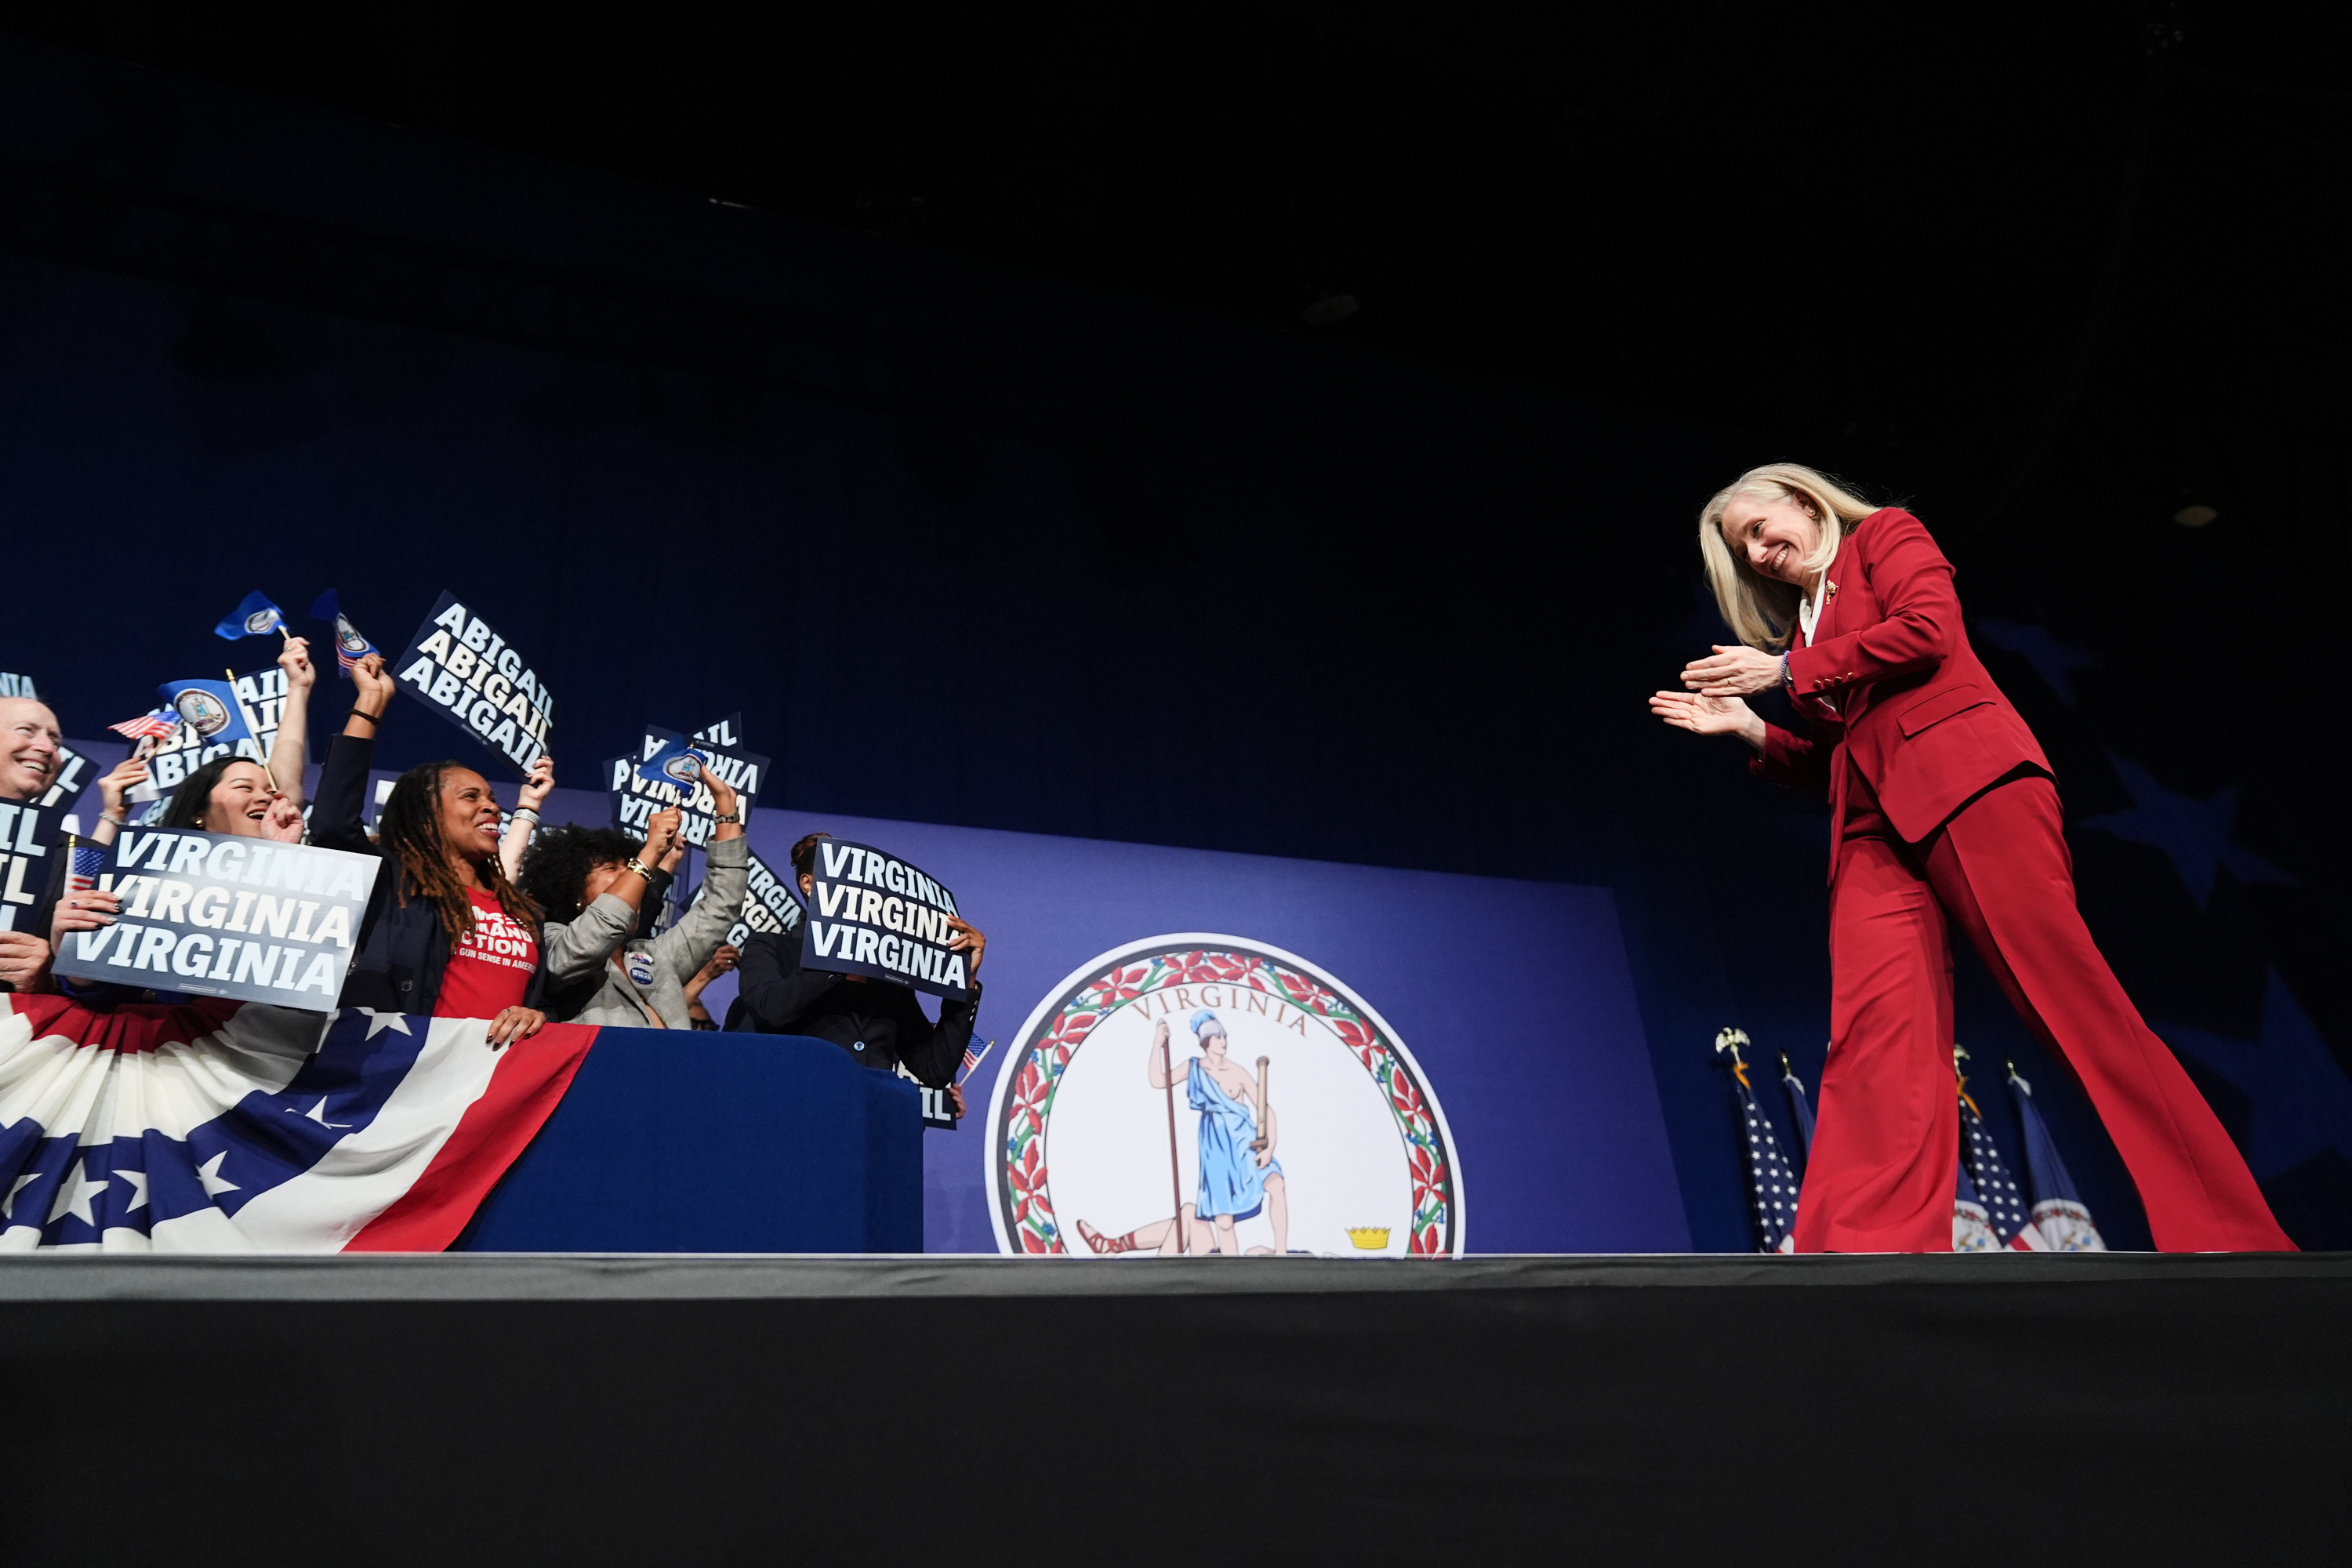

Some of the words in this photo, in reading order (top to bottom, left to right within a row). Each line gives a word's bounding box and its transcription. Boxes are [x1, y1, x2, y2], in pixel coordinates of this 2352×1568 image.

[416, 629, 547, 752] ABIGAIL
[434, 603, 553, 728] ABIGAIL
[398, 655, 543, 774] ABIGAIL
[116, 831, 364, 902] VIRGINIA
[822, 842, 960, 919] VIRGINIA
[98, 873, 350, 948] VIRGINIA
[461, 929, 527, 957] CTION
[816, 881, 962, 946] VIRGINI
[76, 922, 336, 996] VIRGINIA
[459, 947, 476, 958] GUN
[477, 952, 501, 964] SENSE
[502, 957, 510, 967] IN
[811, 920, 966, 989] VIRGINIA
[1131, 985, 1307, 1037] VIRGINIA
